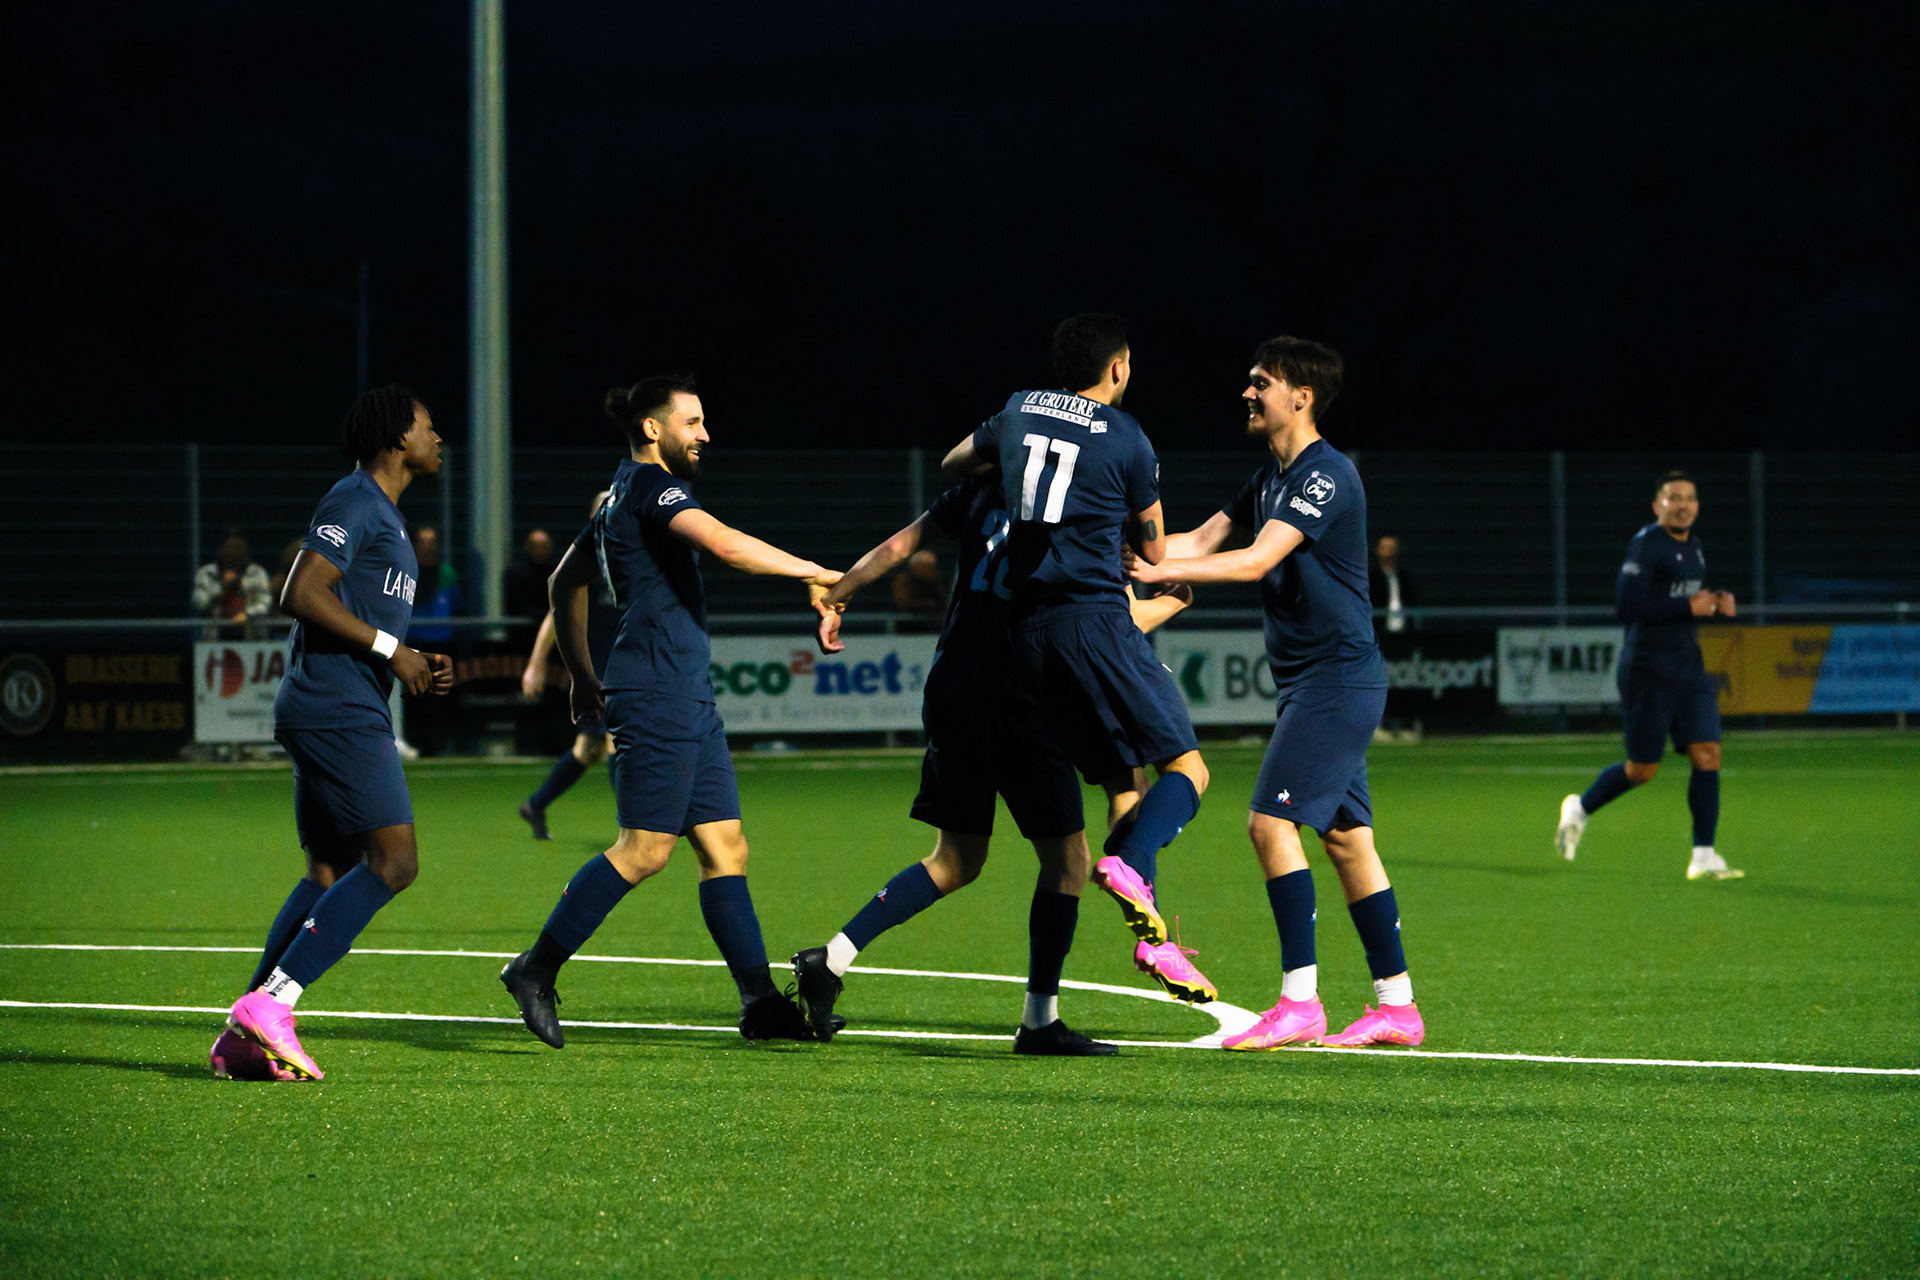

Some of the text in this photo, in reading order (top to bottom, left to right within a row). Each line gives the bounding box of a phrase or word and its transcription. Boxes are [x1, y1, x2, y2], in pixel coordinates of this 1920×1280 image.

[1023, 405, 1088, 425] SWITZERLAND
[1024, 391, 1096, 418] LE GRUYÈRE
[383, 567, 402, 598] LA
[65, 654, 184, 684] BRASSERIE
[115, 702, 185, 730] KAESS
